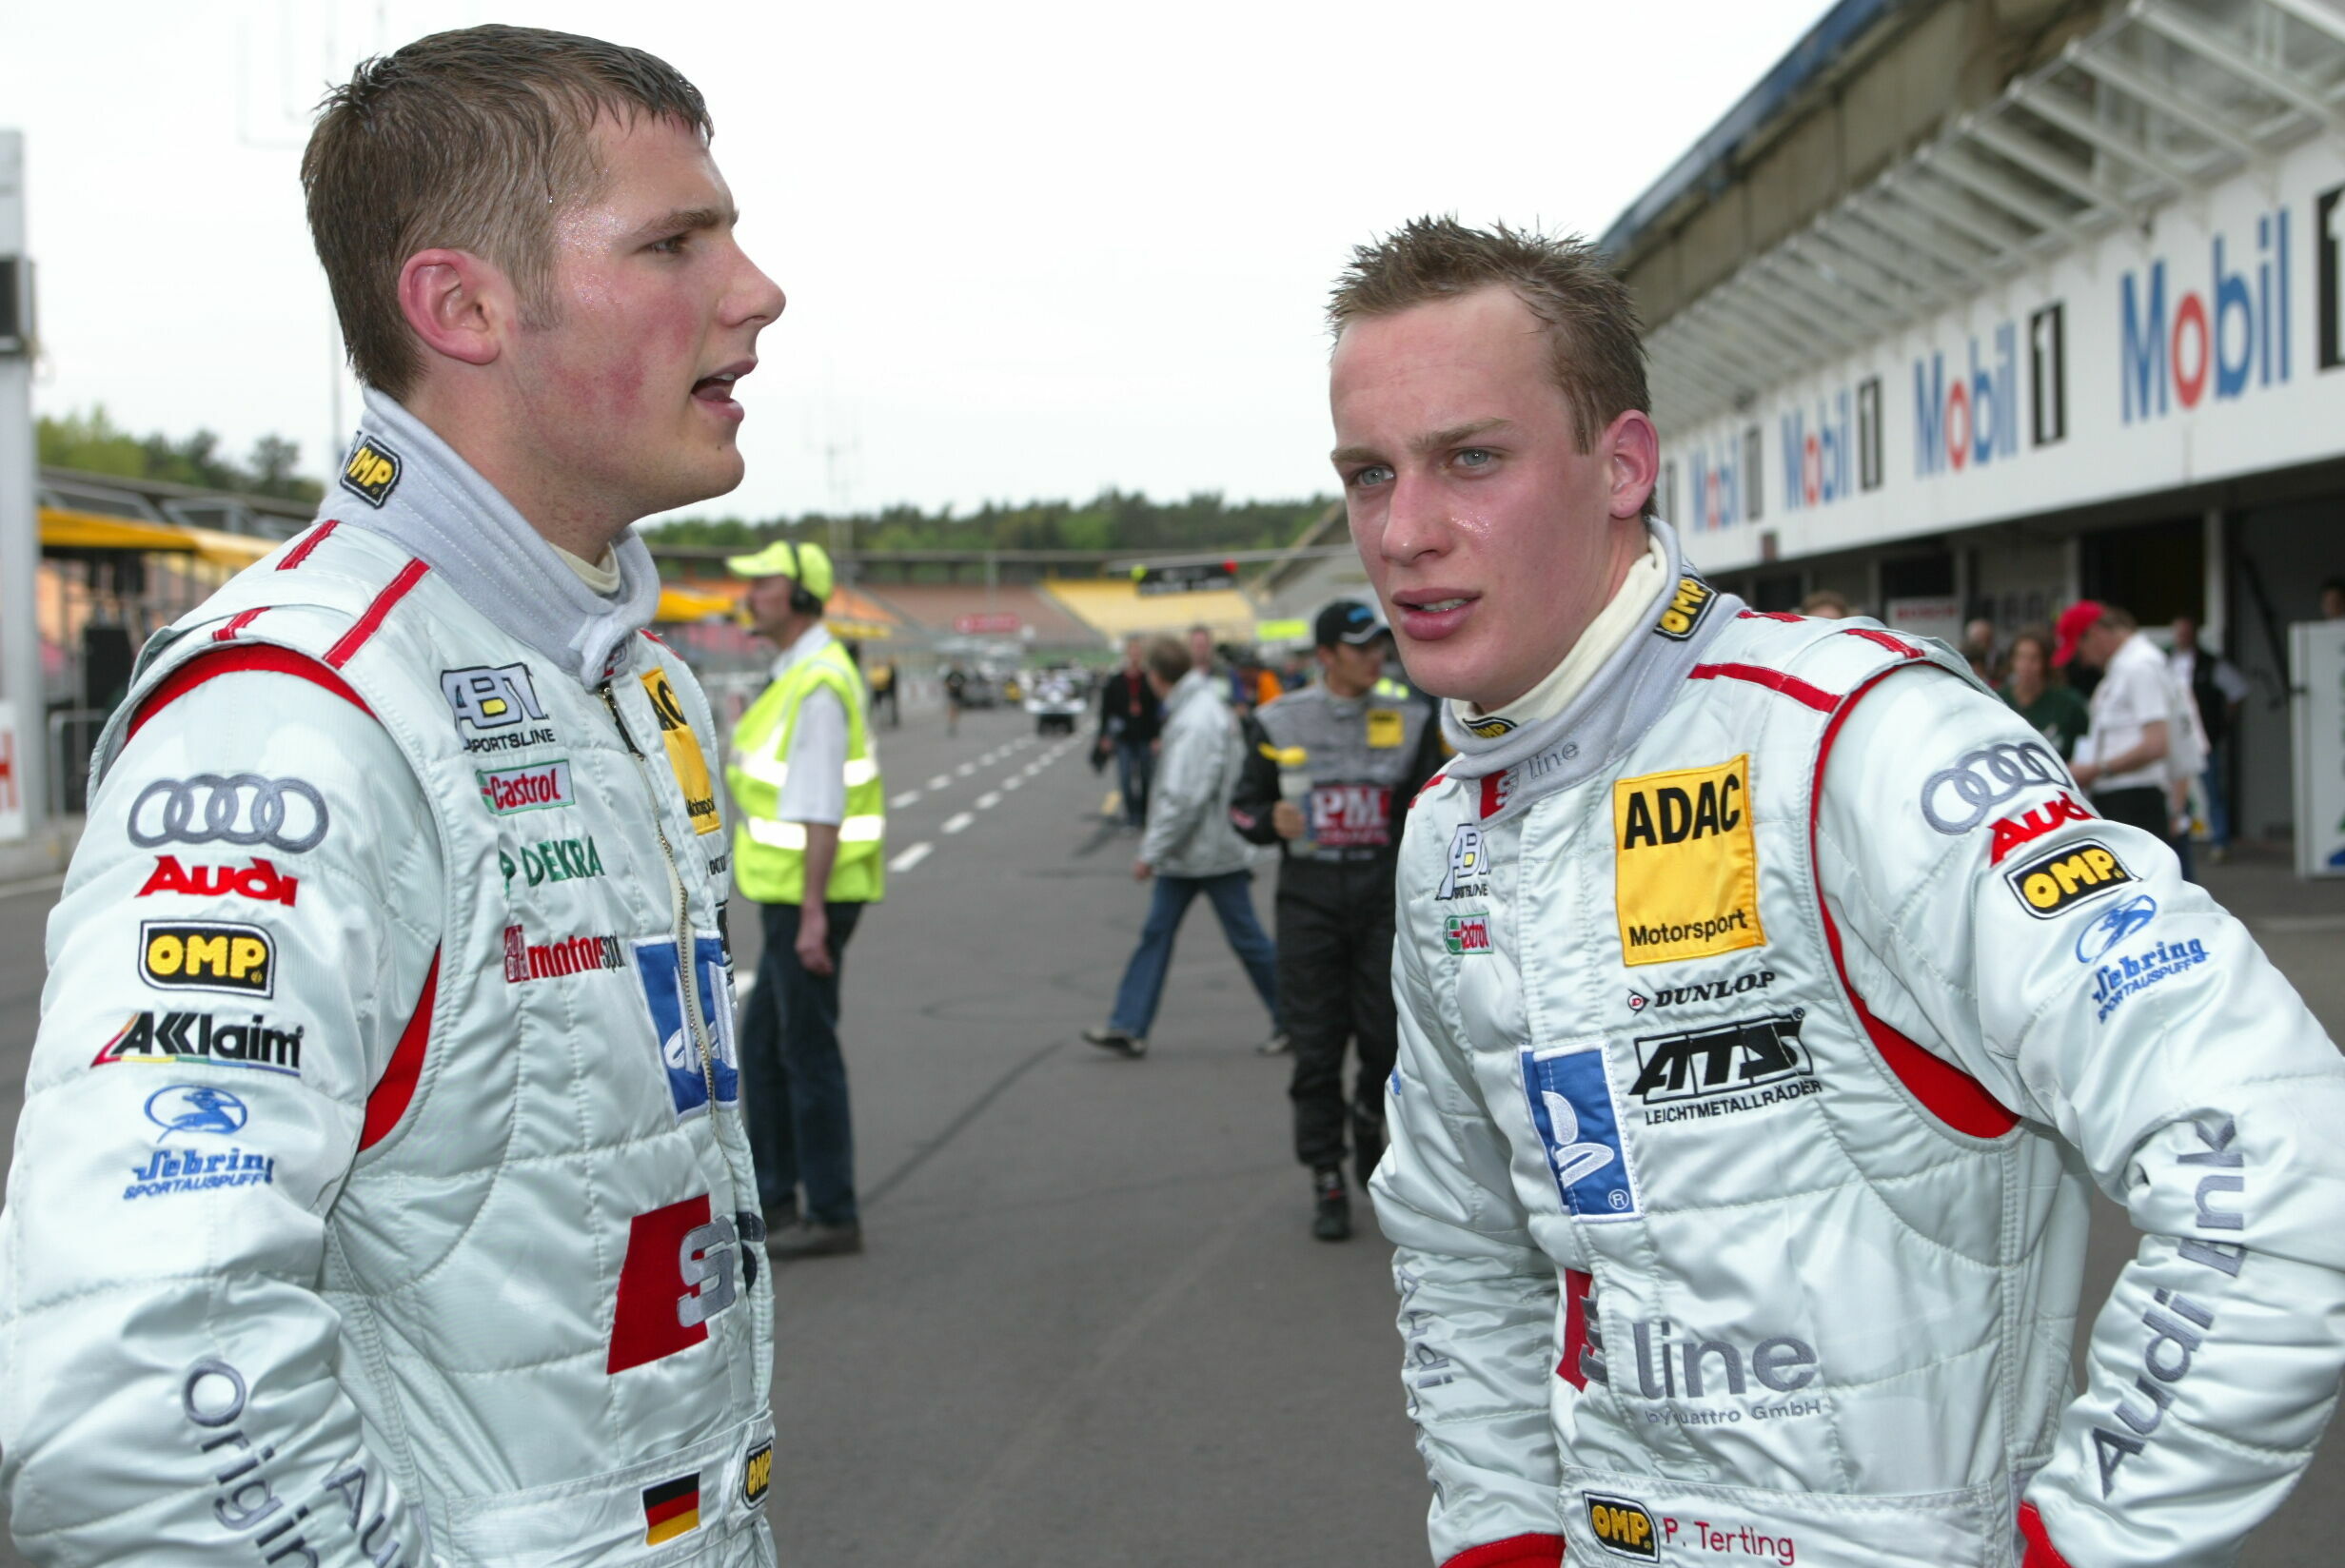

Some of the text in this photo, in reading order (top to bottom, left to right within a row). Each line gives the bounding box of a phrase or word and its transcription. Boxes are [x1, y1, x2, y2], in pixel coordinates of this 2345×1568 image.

[2120, 206, 2292, 427] Mobil
[1914, 304, 2063, 480] Mobil 1
[1782, 386, 1853, 513] Mobil
[1691, 432, 1742, 534] Mobil
[1660, 578, 1706, 634] OMP
[1527, 741, 1579, 780] line
[490, 768, 561, 810] Castrol
[1624, 774, 1741, 850] ADAC
[134, 854, 298, 908] Audi
[520, 835, 605, 888] DEKRA
[2023, 848, 2117, 908] OMP
[1628, 909, 1747, 948] Motorsport
[148, 934, 266, 979] OMP
[1655, 971, 1775, 1008] DUNLOP
[1628, 1020, 1803, 1096] ATS
[1645, 1079, 1823, 1126] LEICHTMETALLRÄDER
[123, 1171, 265, 1201] SPORTAUSPUFF
[677, 1214, 736, 1328] S
[1632, 1319, 1818, 1401] line
[1751, 1401, 1822, 1421] GmbH
[2092, 1285, 2216, 1500] Audi
[747, 1449, 773, 1496] OMP
[1591, 1505, 1651, 1546] OMP
[1663, 1518, 1795, 1566] P. Terting
